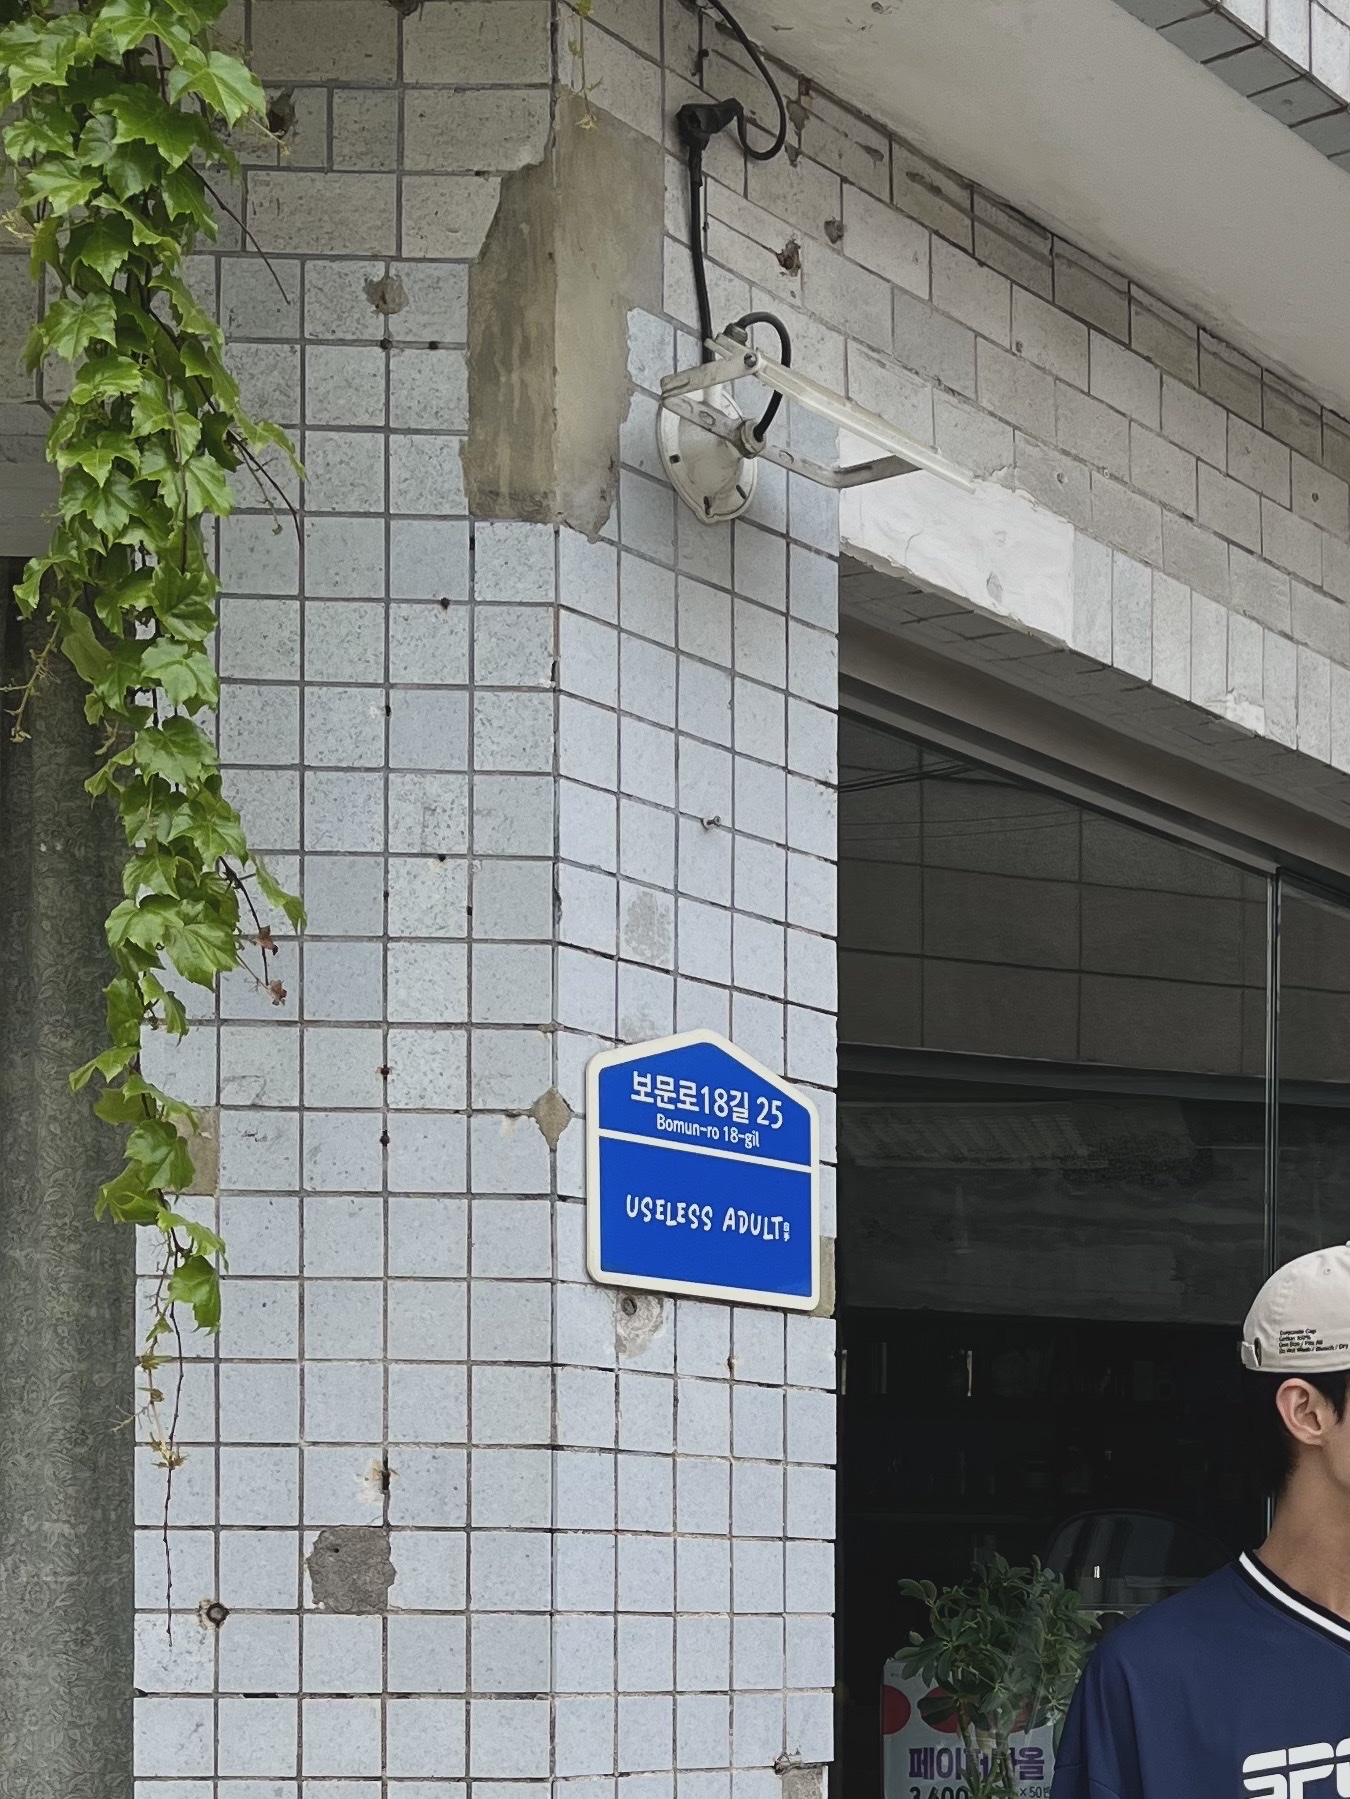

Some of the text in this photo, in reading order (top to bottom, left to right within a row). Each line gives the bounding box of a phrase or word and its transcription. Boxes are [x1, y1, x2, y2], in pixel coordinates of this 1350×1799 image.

[630, 1070, 784, 1130] 보문로18길 25
[656, 1113, 760, 1149] Bomun-ro 18-gil
[626, 1194, 713, 1232] USELESS
